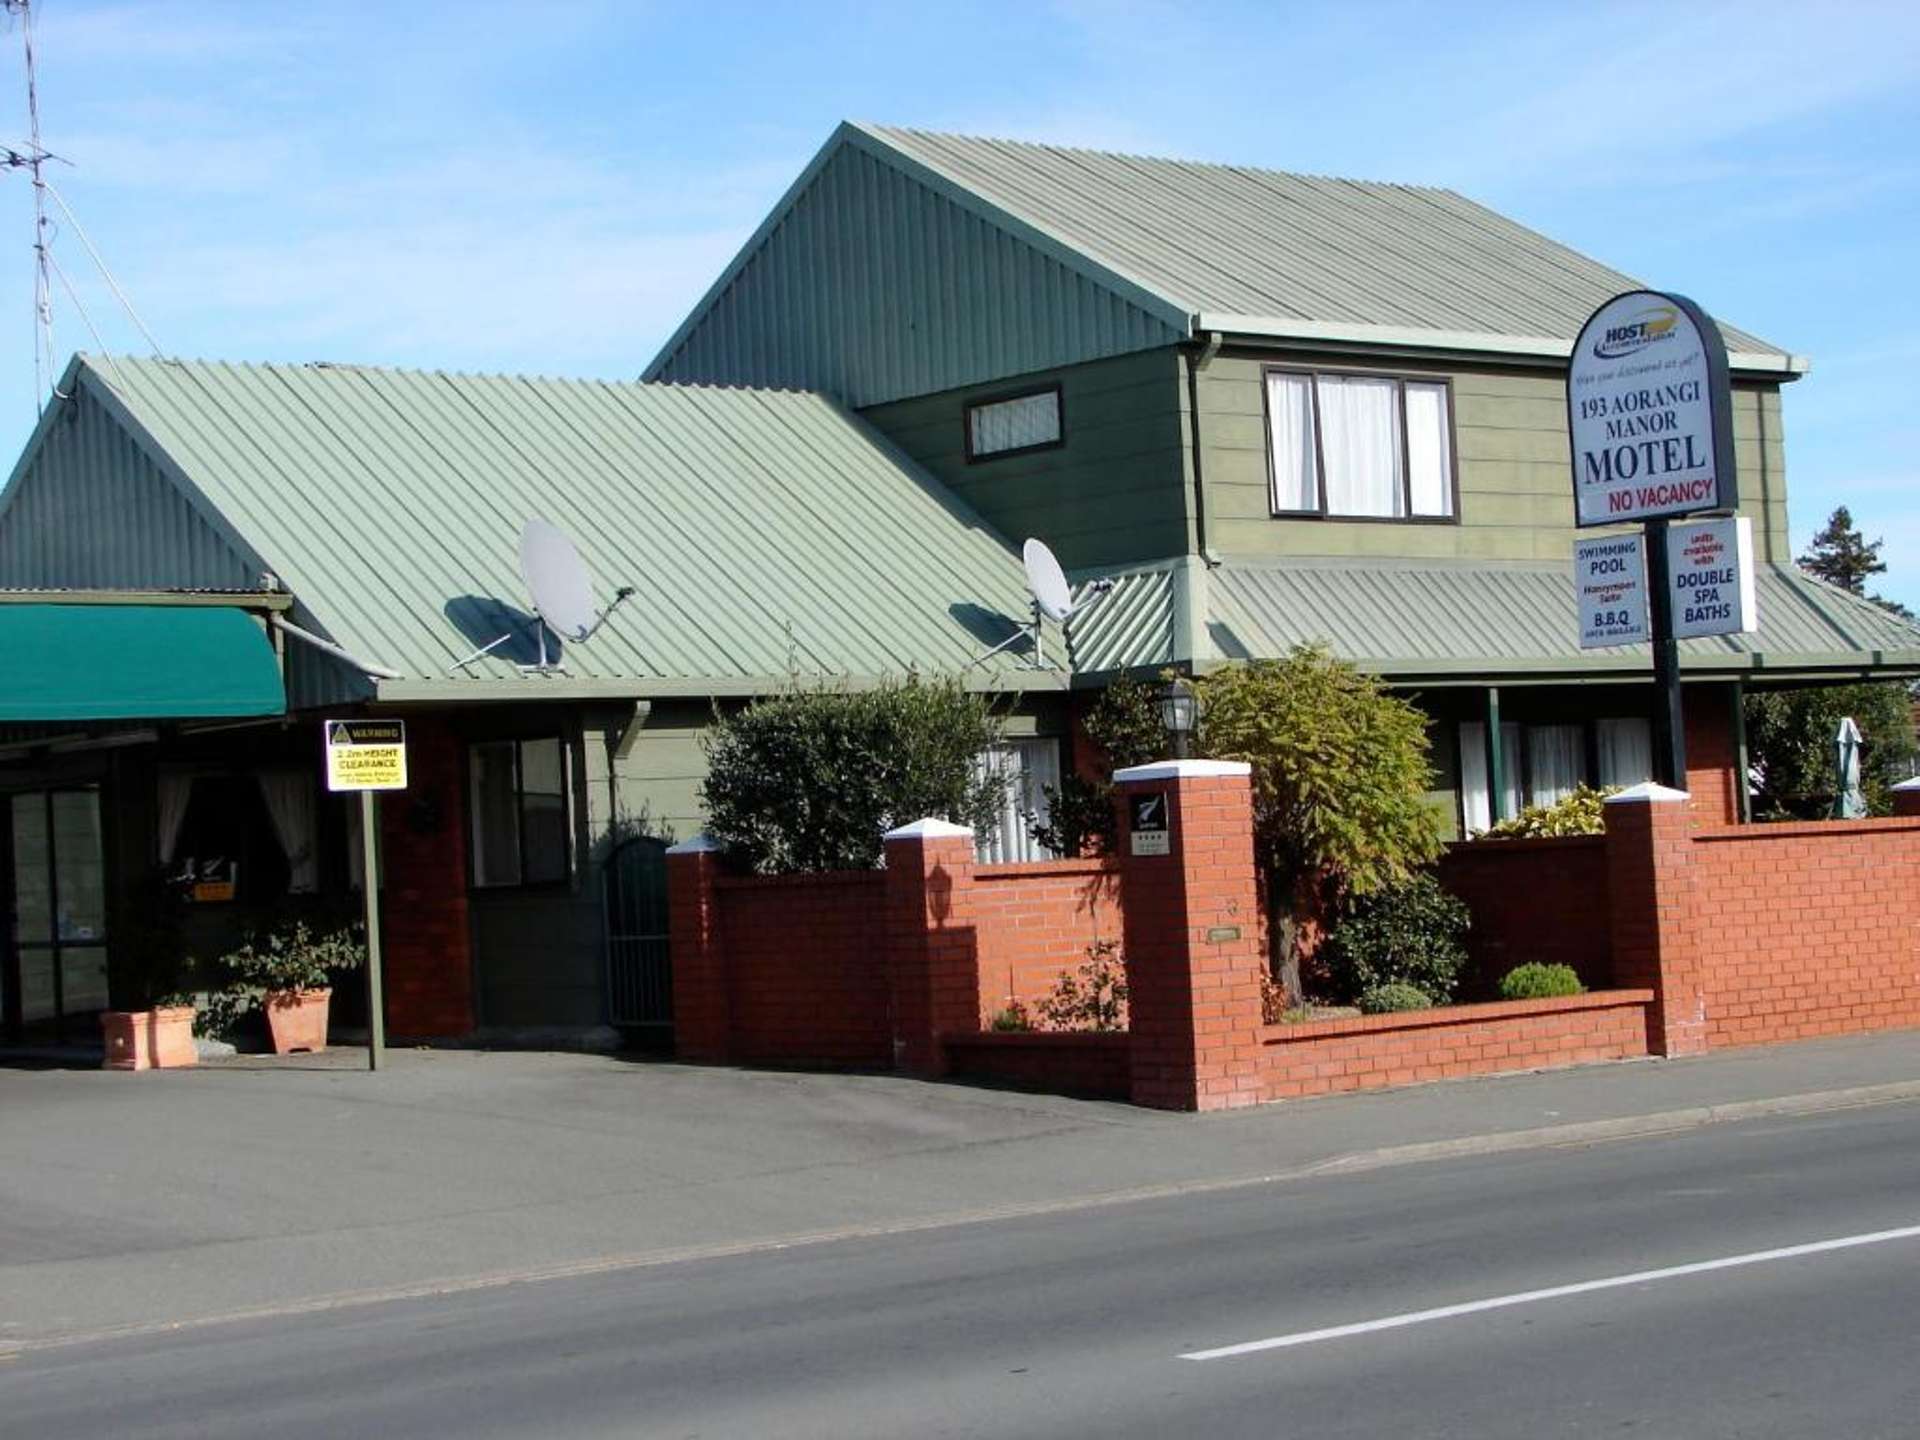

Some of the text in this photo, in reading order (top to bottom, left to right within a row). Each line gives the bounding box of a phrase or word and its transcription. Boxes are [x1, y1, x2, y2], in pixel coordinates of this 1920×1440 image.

[1606, 323, 1648, 342] HOST
[1581, 380, 1700, 419] 193 AORANGI
[1605, 410, 1678, 440] MANOR
[1584, 434, 1706, 485] MOTEL
[1608, 478, 1713, 513] NO VACANCY
[1579, 542, 1636, 560] SWIMMING
[1590, 560, 1627, 576] POOL
[1677, 568, 1734, 589] DOUBLE
[1694, 589, 1720, 604] SPA
[1594, 610, 1630, 627] B.B.Q
[1684, 604, 1731, 623] BATHS
[352, 728, 399, 738] WARNING
[363, 748, 398, 758] HEIGHT
[339, 759, 396, 770] CLEARANCE
